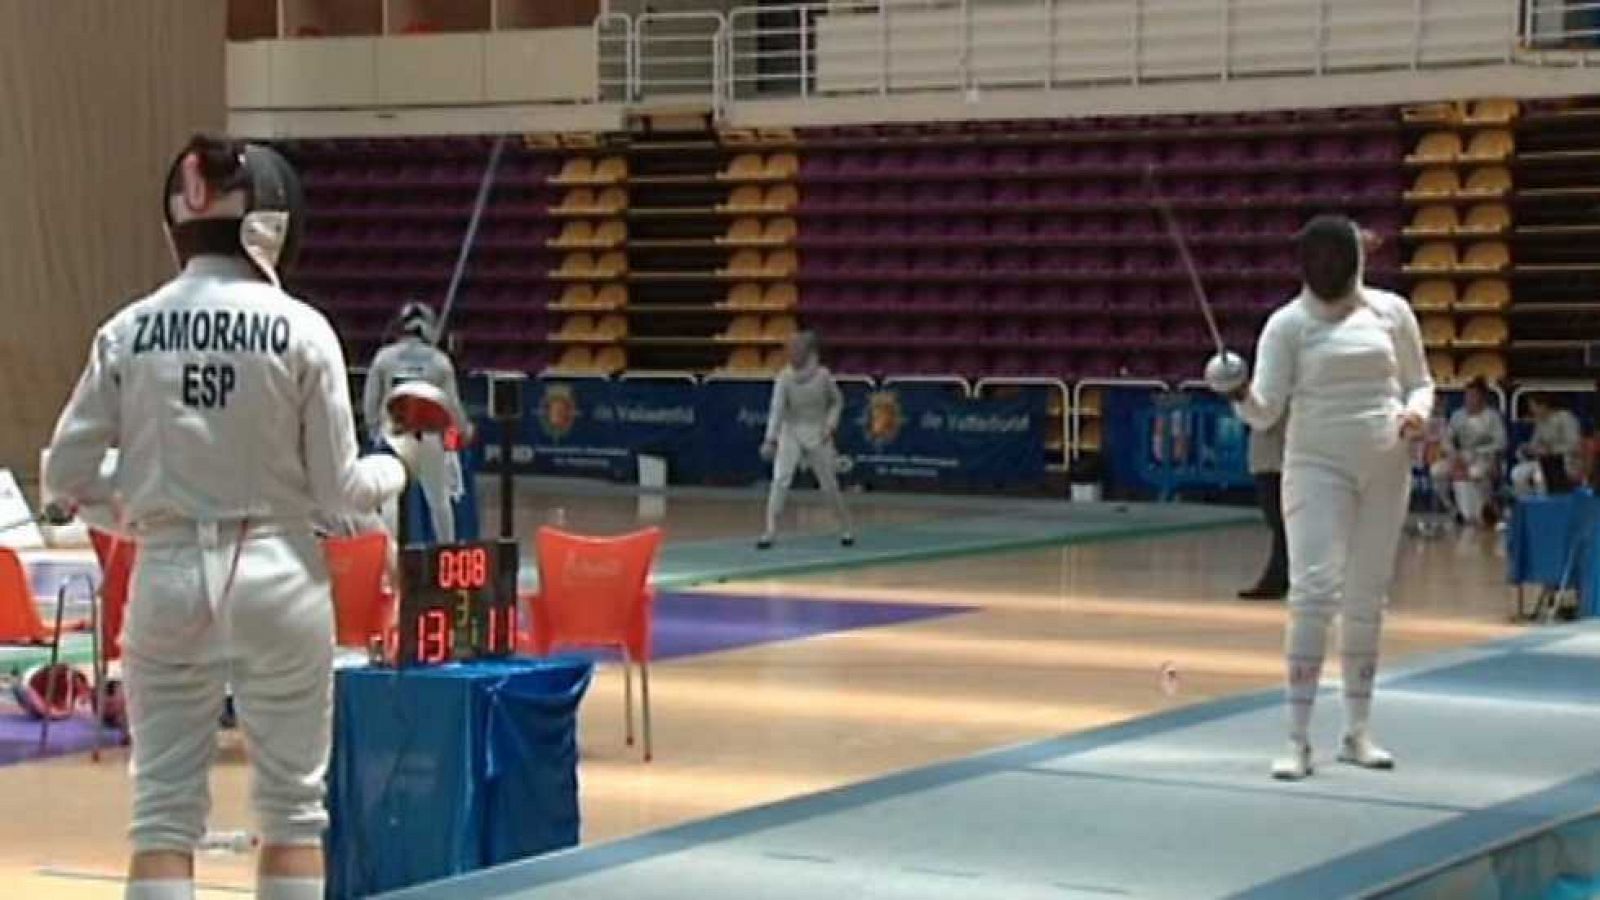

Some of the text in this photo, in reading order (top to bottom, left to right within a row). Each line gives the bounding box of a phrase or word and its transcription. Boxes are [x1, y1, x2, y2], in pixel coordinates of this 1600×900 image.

[133, 309, 290, 354] ZAMORANO
[183, 363, 236, 408] ESP
[438, 548, 486, 589] 0:08
[417, 610, 446, 663] 13
[488, 605, 515, 652] 11
